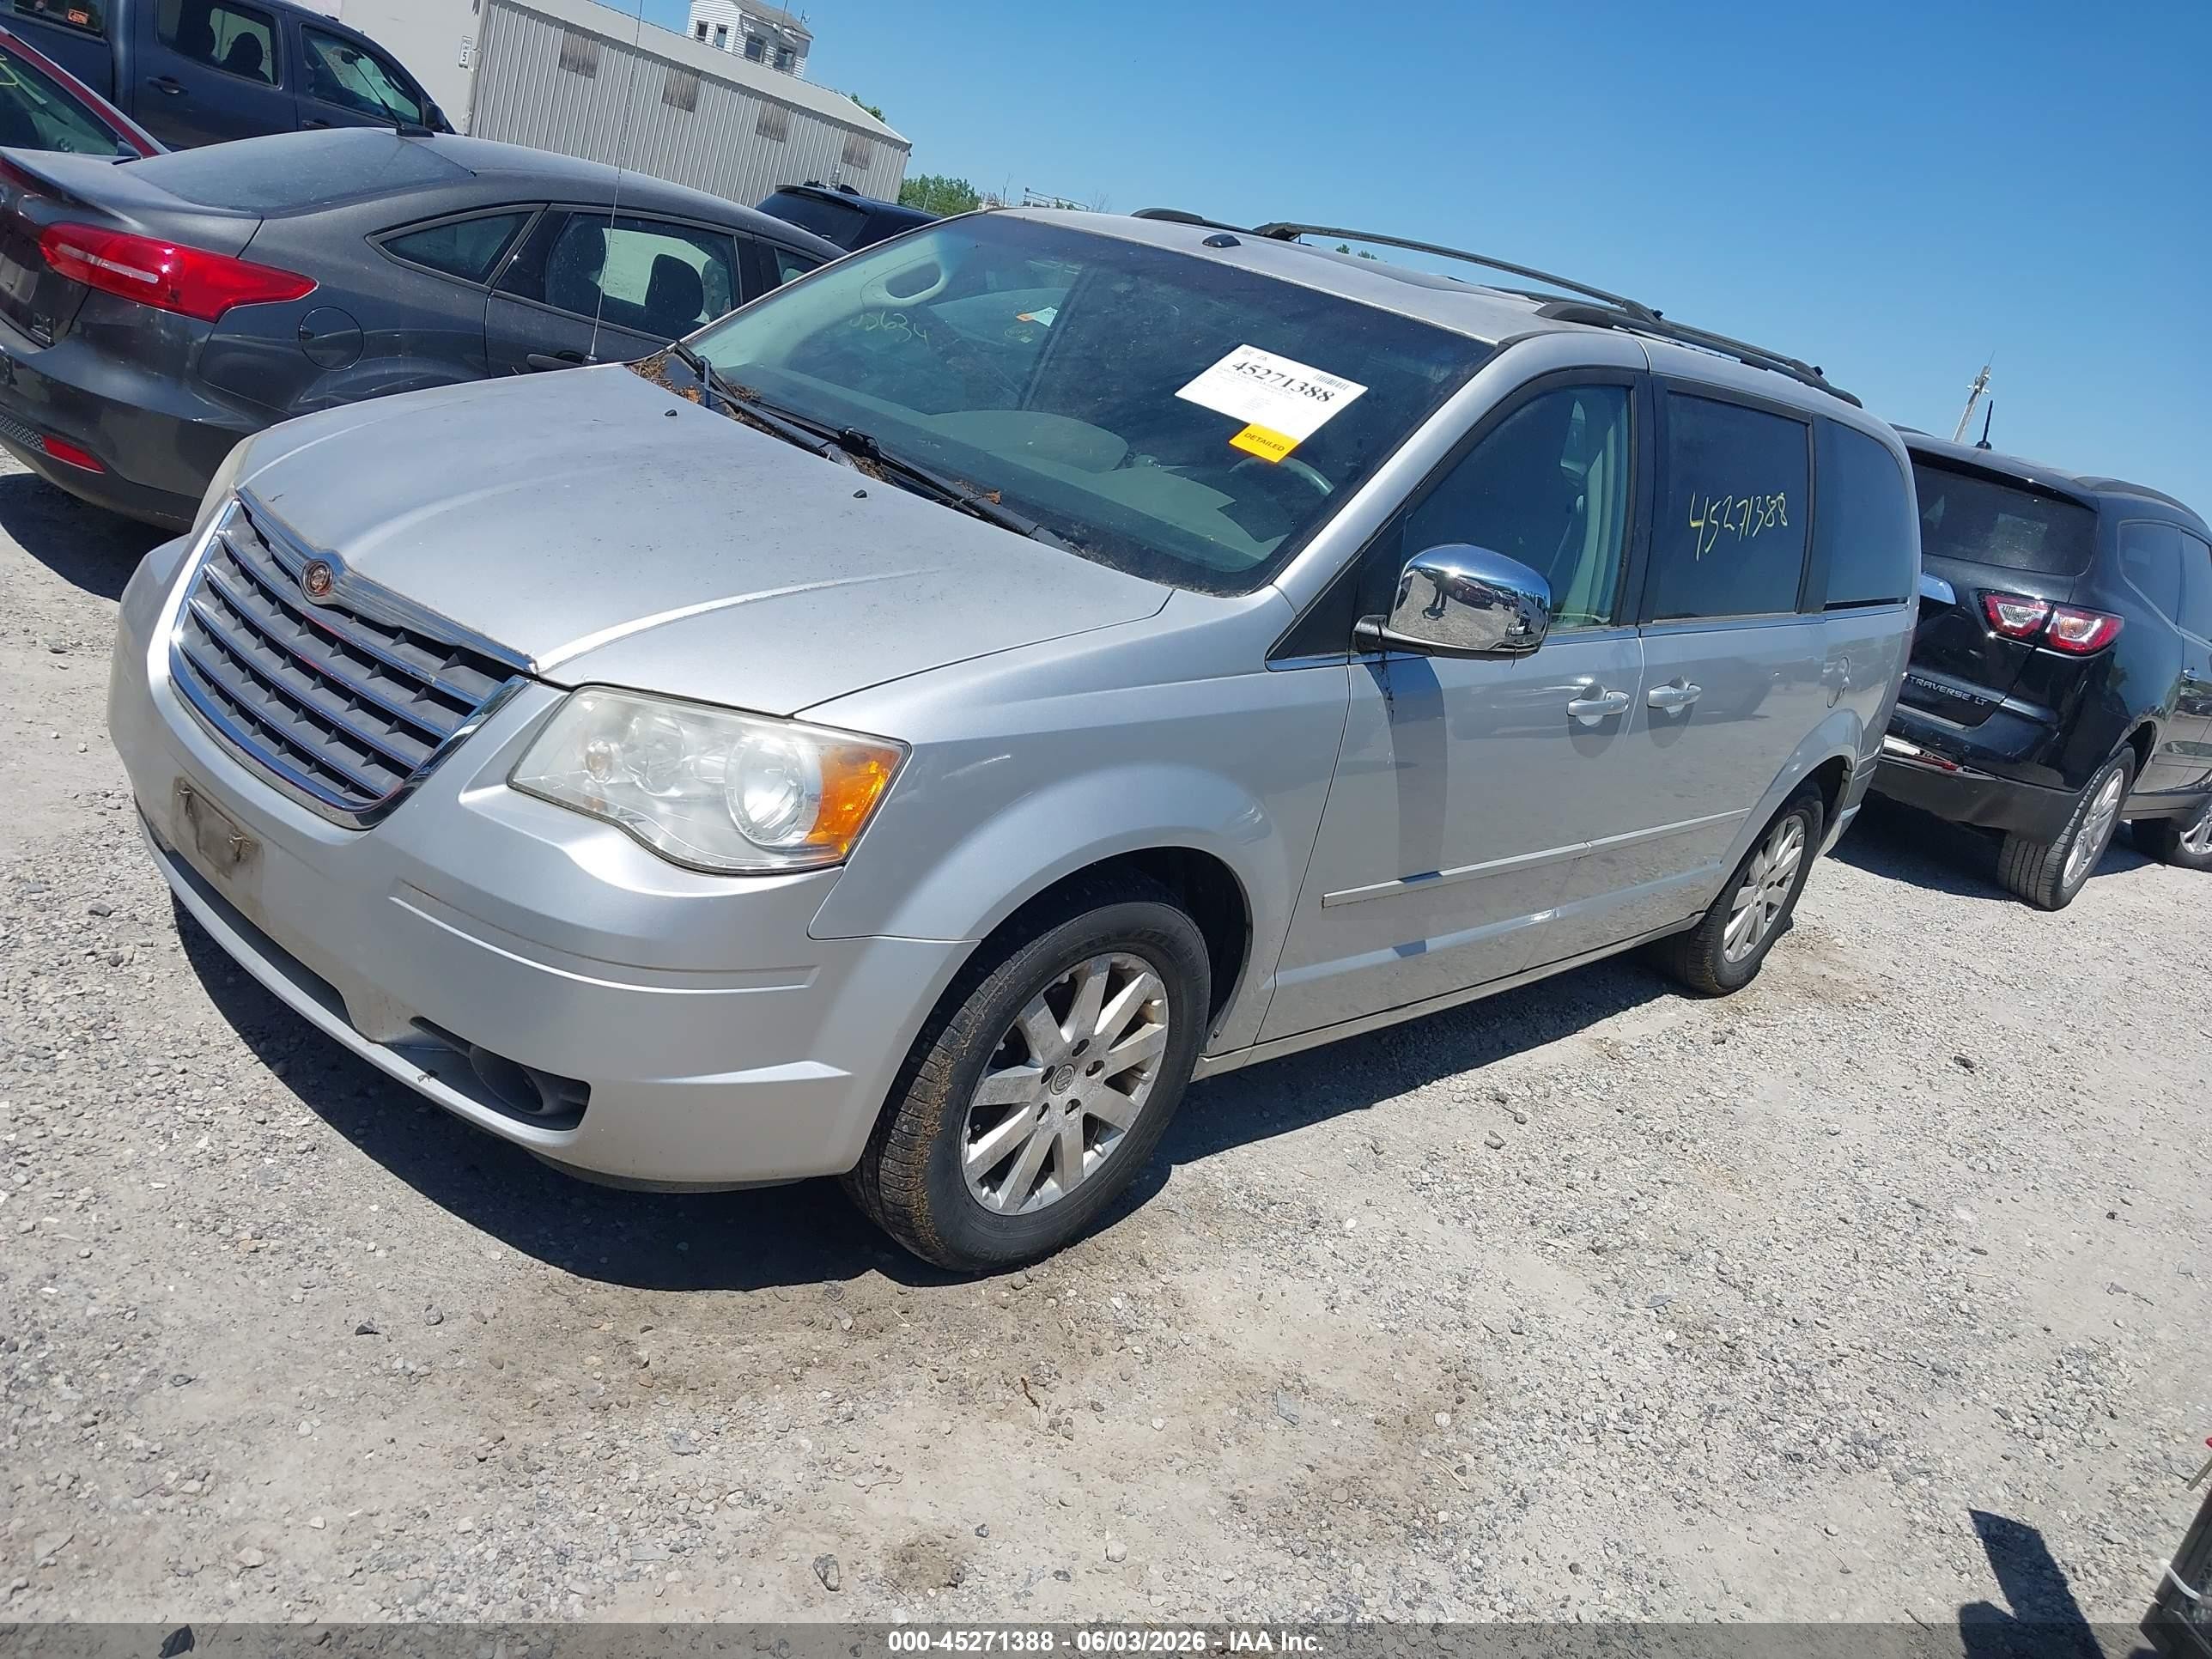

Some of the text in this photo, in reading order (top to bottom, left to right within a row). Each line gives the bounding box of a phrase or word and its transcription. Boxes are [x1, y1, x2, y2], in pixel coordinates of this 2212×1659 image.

[462, 52, 467, 62] 5
[1231, 362, 1334, 402] 45271388
[1244, 432, 1285, 452] DETAILED
[1689, 490, 1788, 562] 45271388
[1909, 676, 1988, 706] TRAVERSE LT
